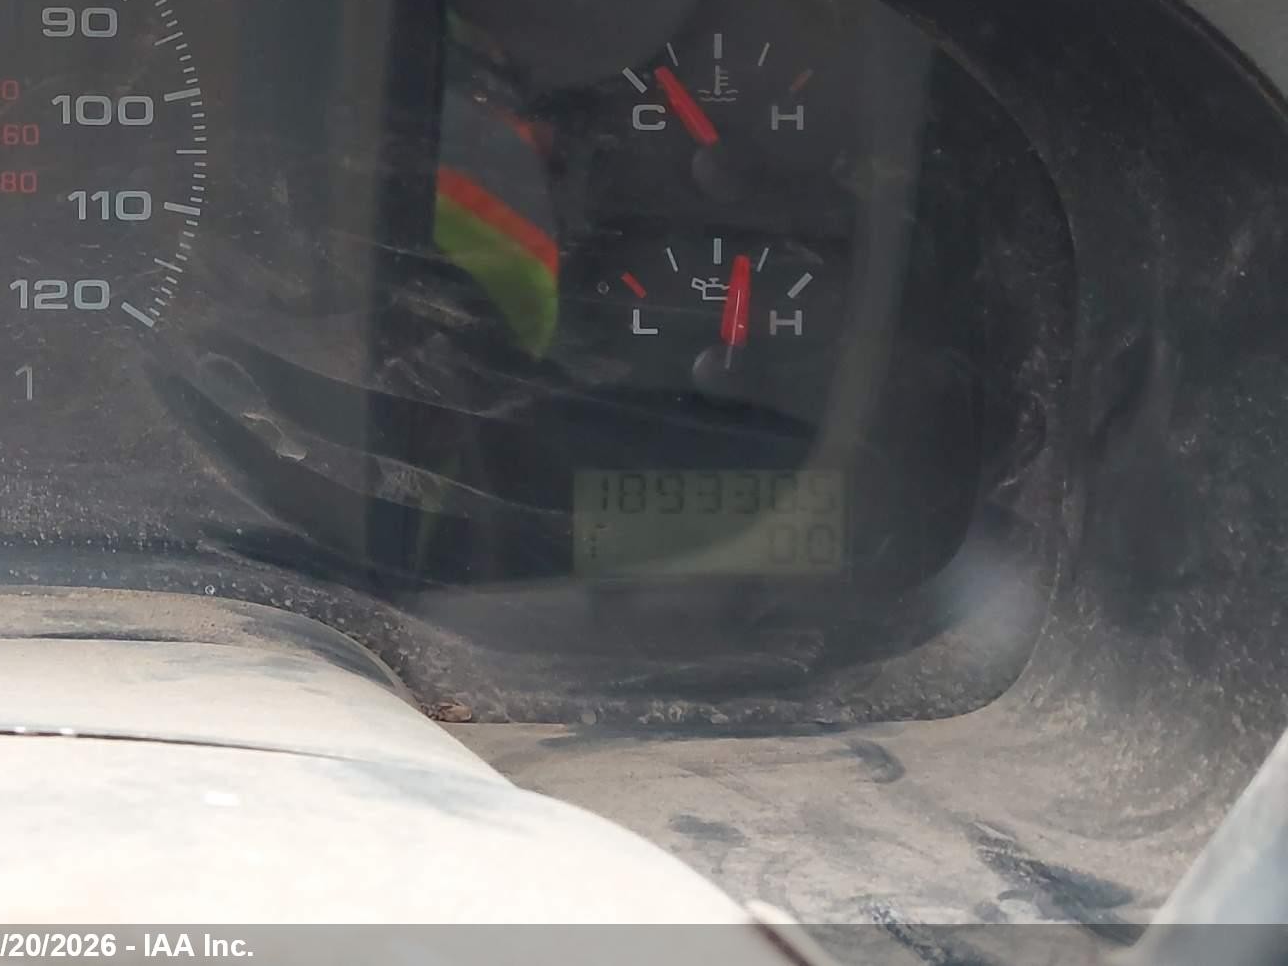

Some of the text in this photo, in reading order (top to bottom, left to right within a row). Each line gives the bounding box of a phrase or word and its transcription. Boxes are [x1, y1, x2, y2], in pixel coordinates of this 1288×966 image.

[41, 7, 118, 38] 90
[52, 95, 154, 126] 100
[632, 104, 667, 131] C
[770, 105, 804, 131] H
[67, 190, 153, 221] 110
[9, 280, 111, 310] 120
[633, 309, 658, 335] L
[769, 310, 802, 335] H
